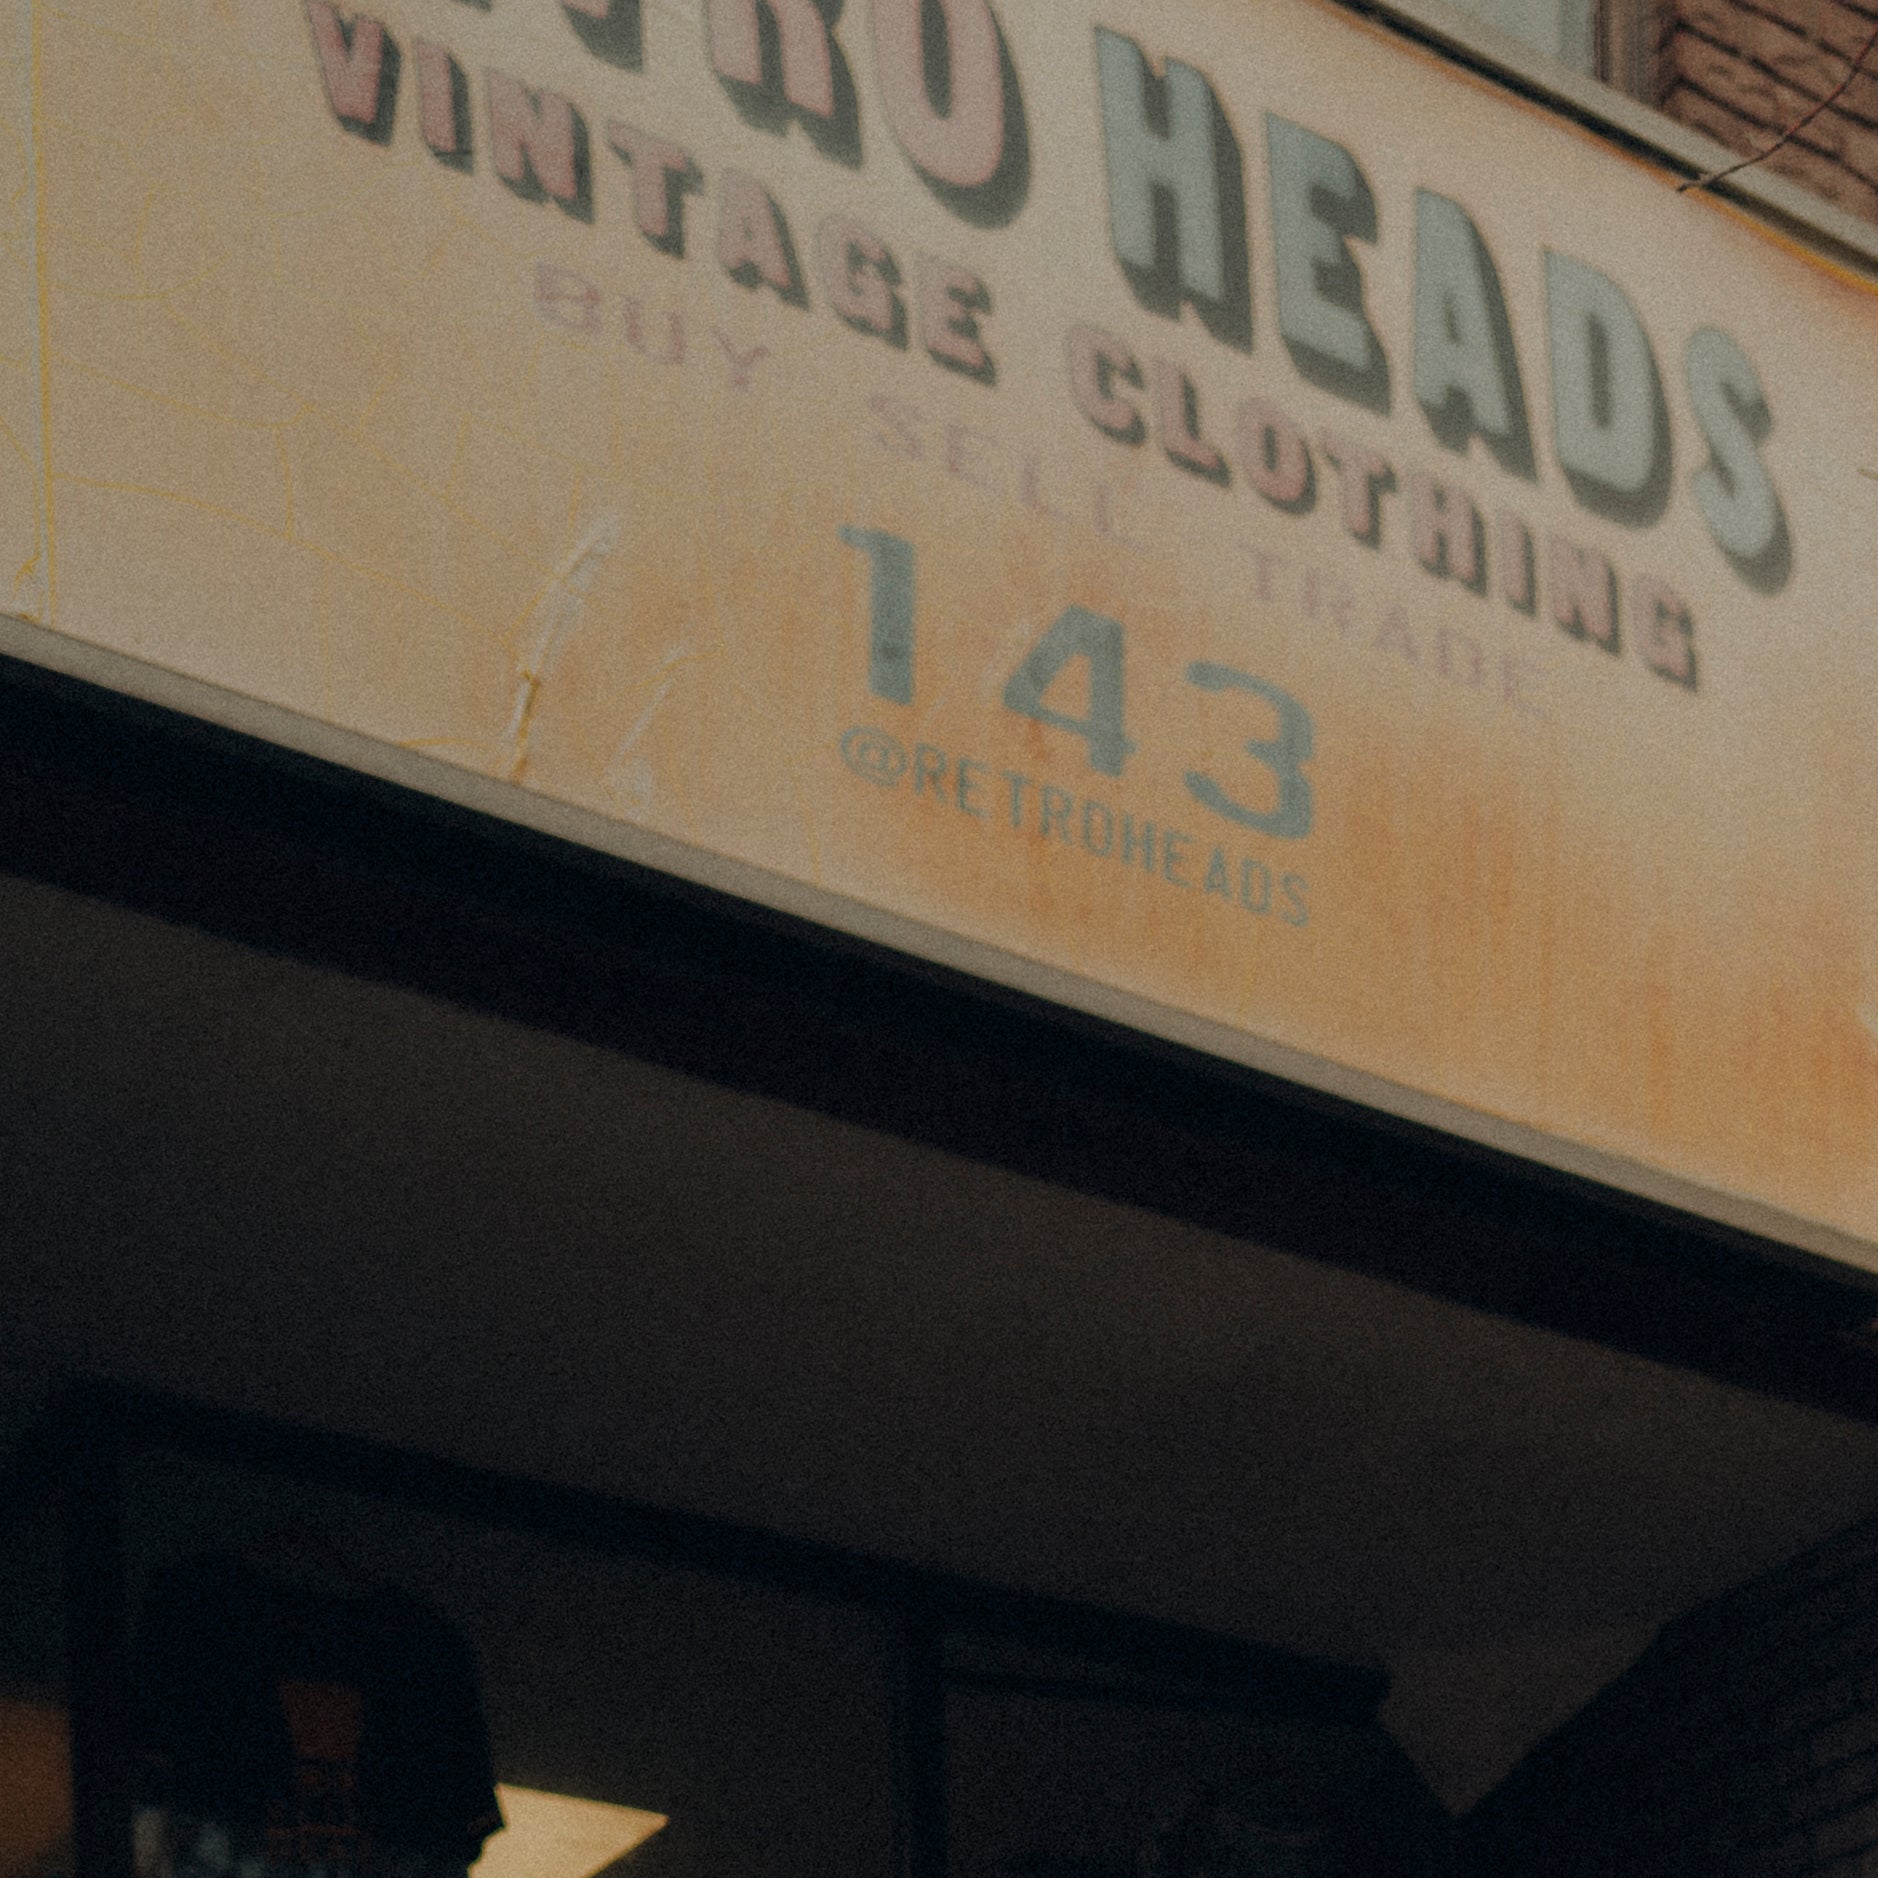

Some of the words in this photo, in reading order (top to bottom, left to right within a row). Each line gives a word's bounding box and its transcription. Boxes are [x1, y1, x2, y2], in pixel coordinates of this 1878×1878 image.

[303, 0, 1000, 387] VINTAGE
[1062, 319, 1700, 694] CLOTHING
[533, 258, 772, 390] BUY
[866, 388, 1150, 553] SELL
[1236, 538, 1555, 718] TRADE
[1093, 25, 1796, 597] HEADS
[836, 522, 1316, 842] 143
[838, 724, 1312, 930] @RETROHEADS
